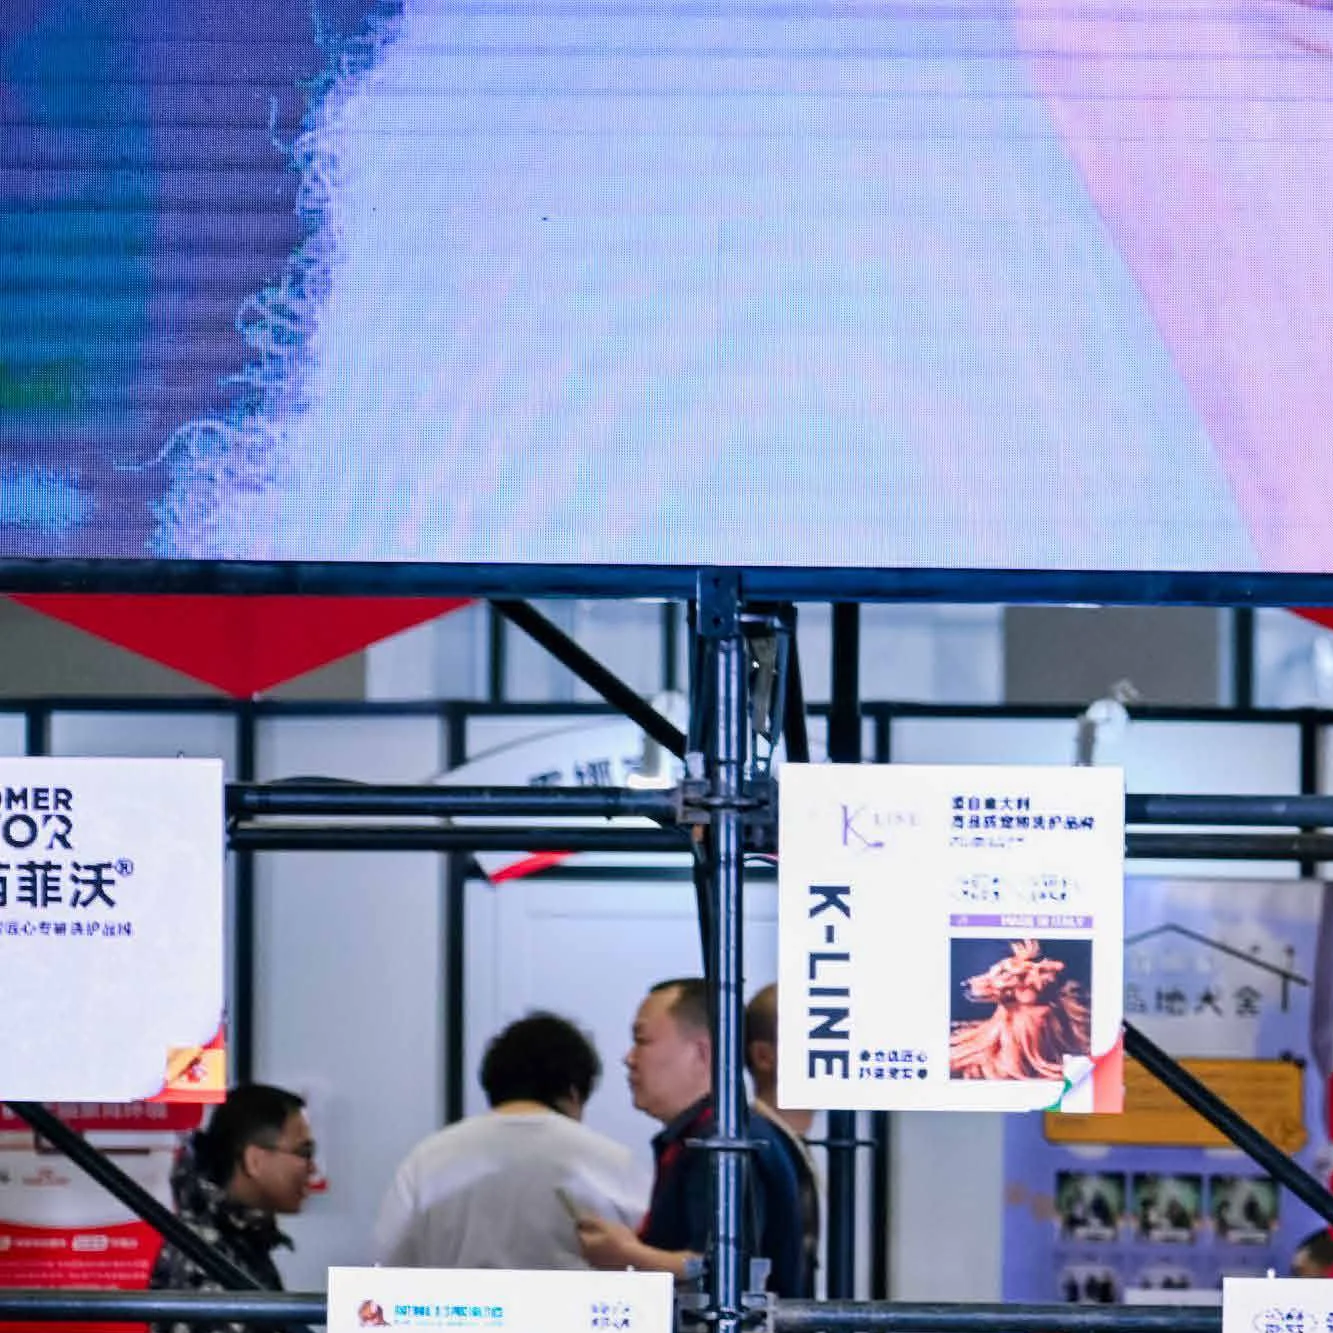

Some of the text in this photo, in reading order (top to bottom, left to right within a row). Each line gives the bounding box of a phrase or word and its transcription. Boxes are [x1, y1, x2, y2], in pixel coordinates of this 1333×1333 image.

[0, 787, 73, 811] MER
[0, 814, 73, 850] OR
[0, 861, 116, 908] 菲沃
[808, 885, 851, 1080] K-LINE
